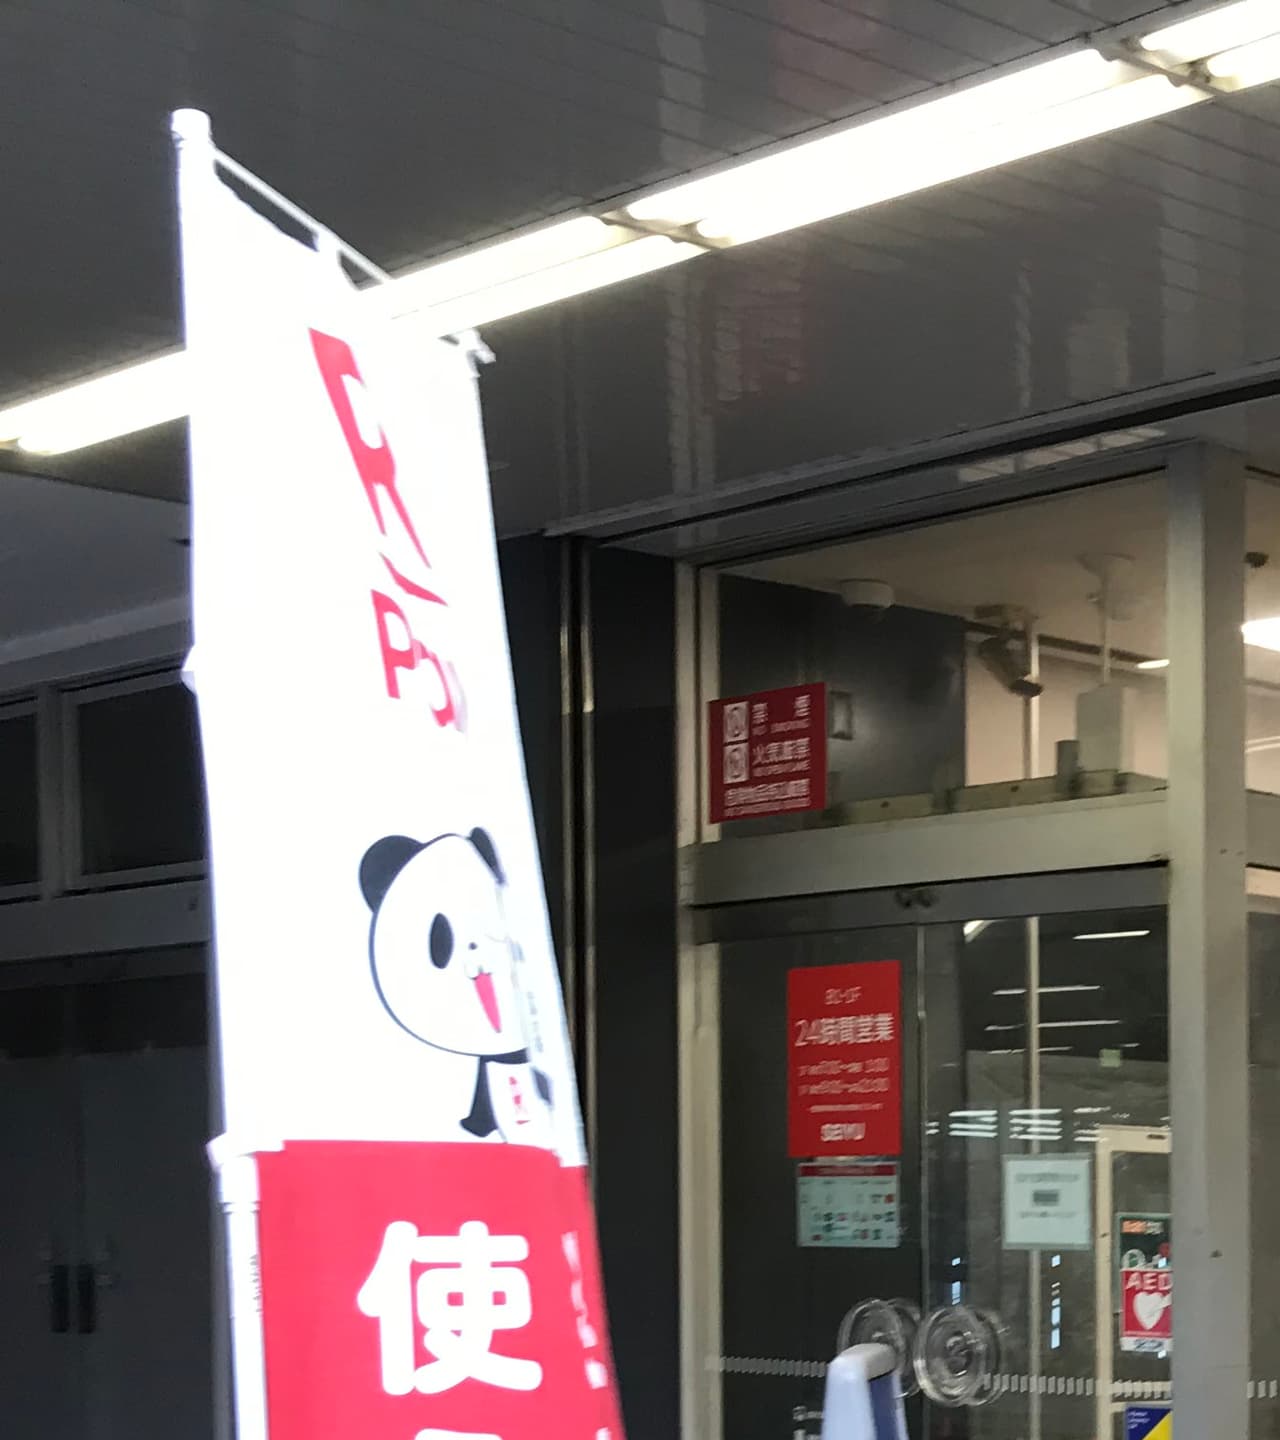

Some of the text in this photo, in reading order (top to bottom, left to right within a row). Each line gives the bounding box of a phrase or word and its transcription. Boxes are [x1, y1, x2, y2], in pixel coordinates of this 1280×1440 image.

[795, 1013, 895, 1046] 24時間営業
[1126, 1272, 1172, 1291] AED
